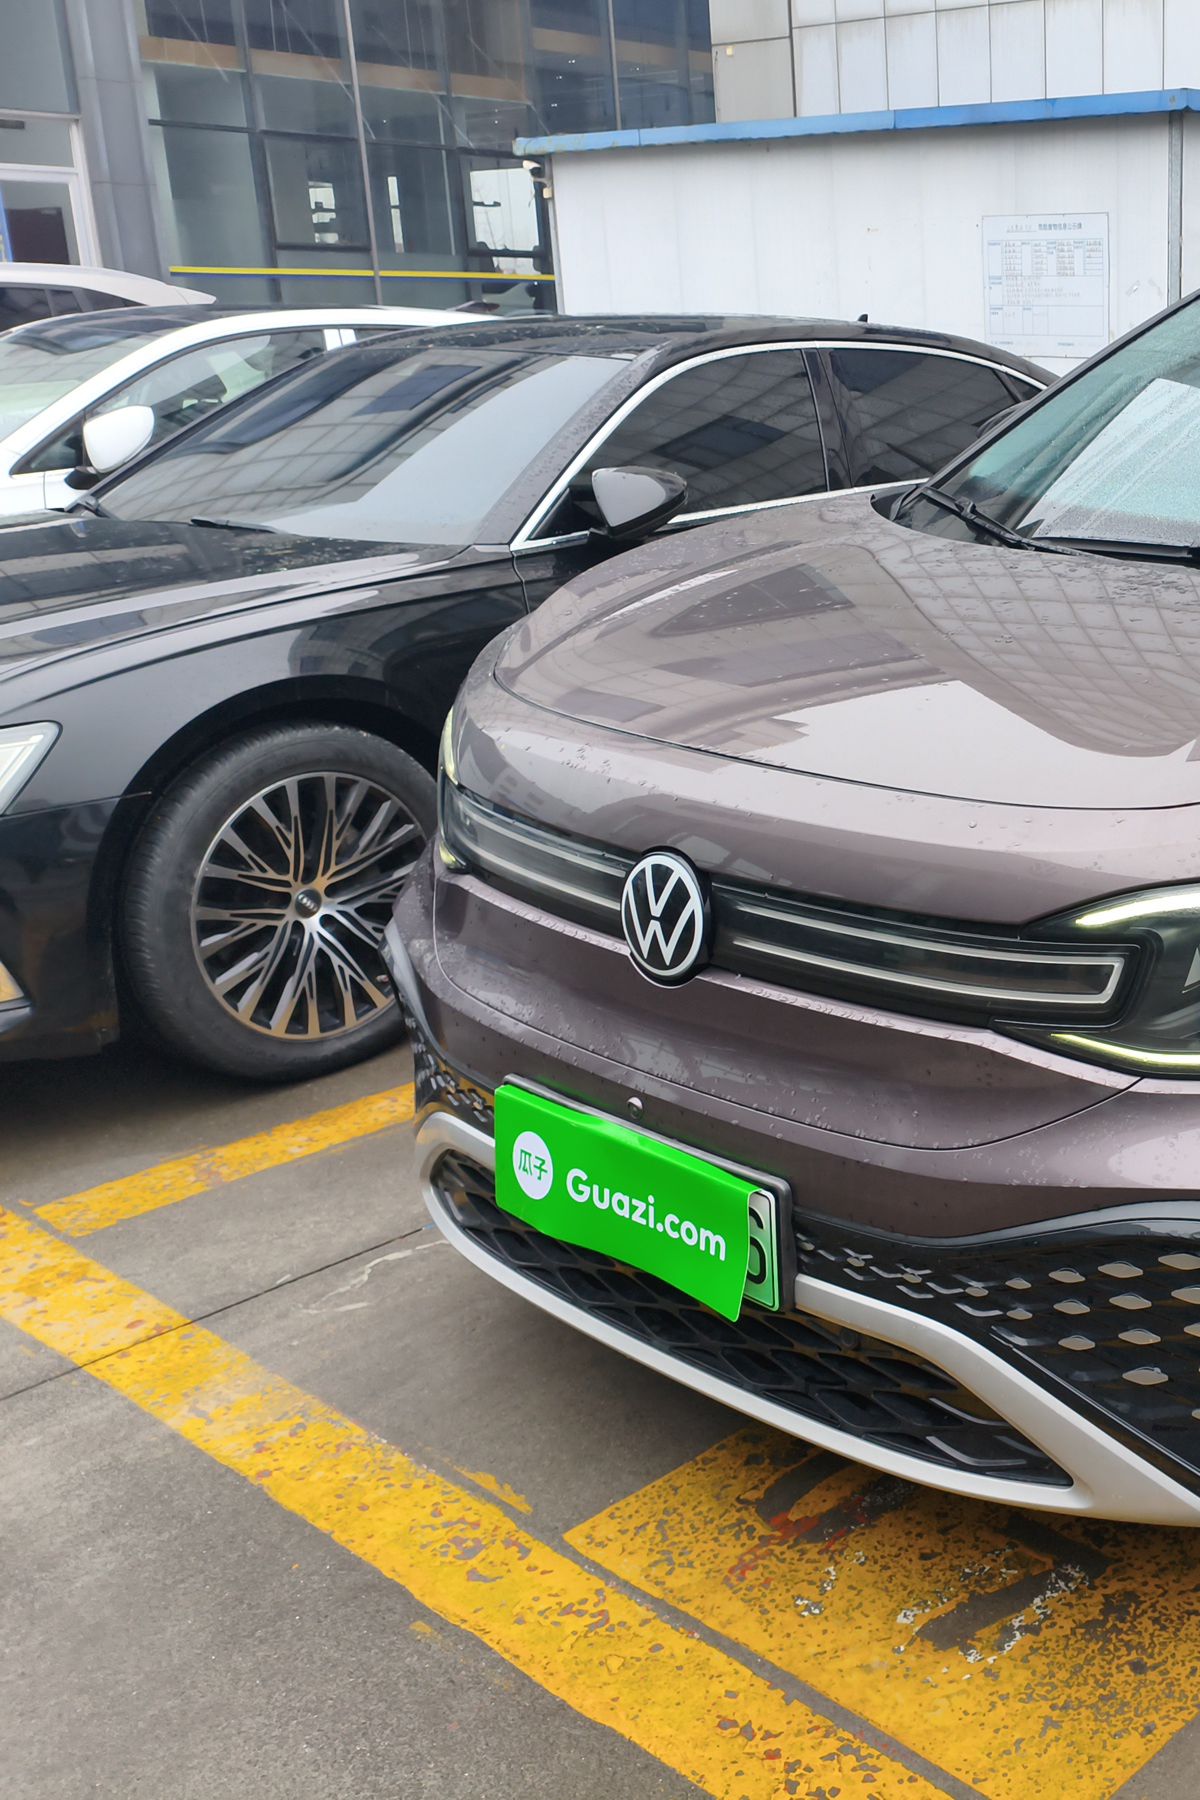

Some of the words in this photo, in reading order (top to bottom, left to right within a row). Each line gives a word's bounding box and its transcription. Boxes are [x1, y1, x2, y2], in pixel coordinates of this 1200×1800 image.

[622, 853, 703, 976] VW
[516, 1147, 549, 1182] 瓜子
[565, 1167, 727, 1263] Guazi.com
